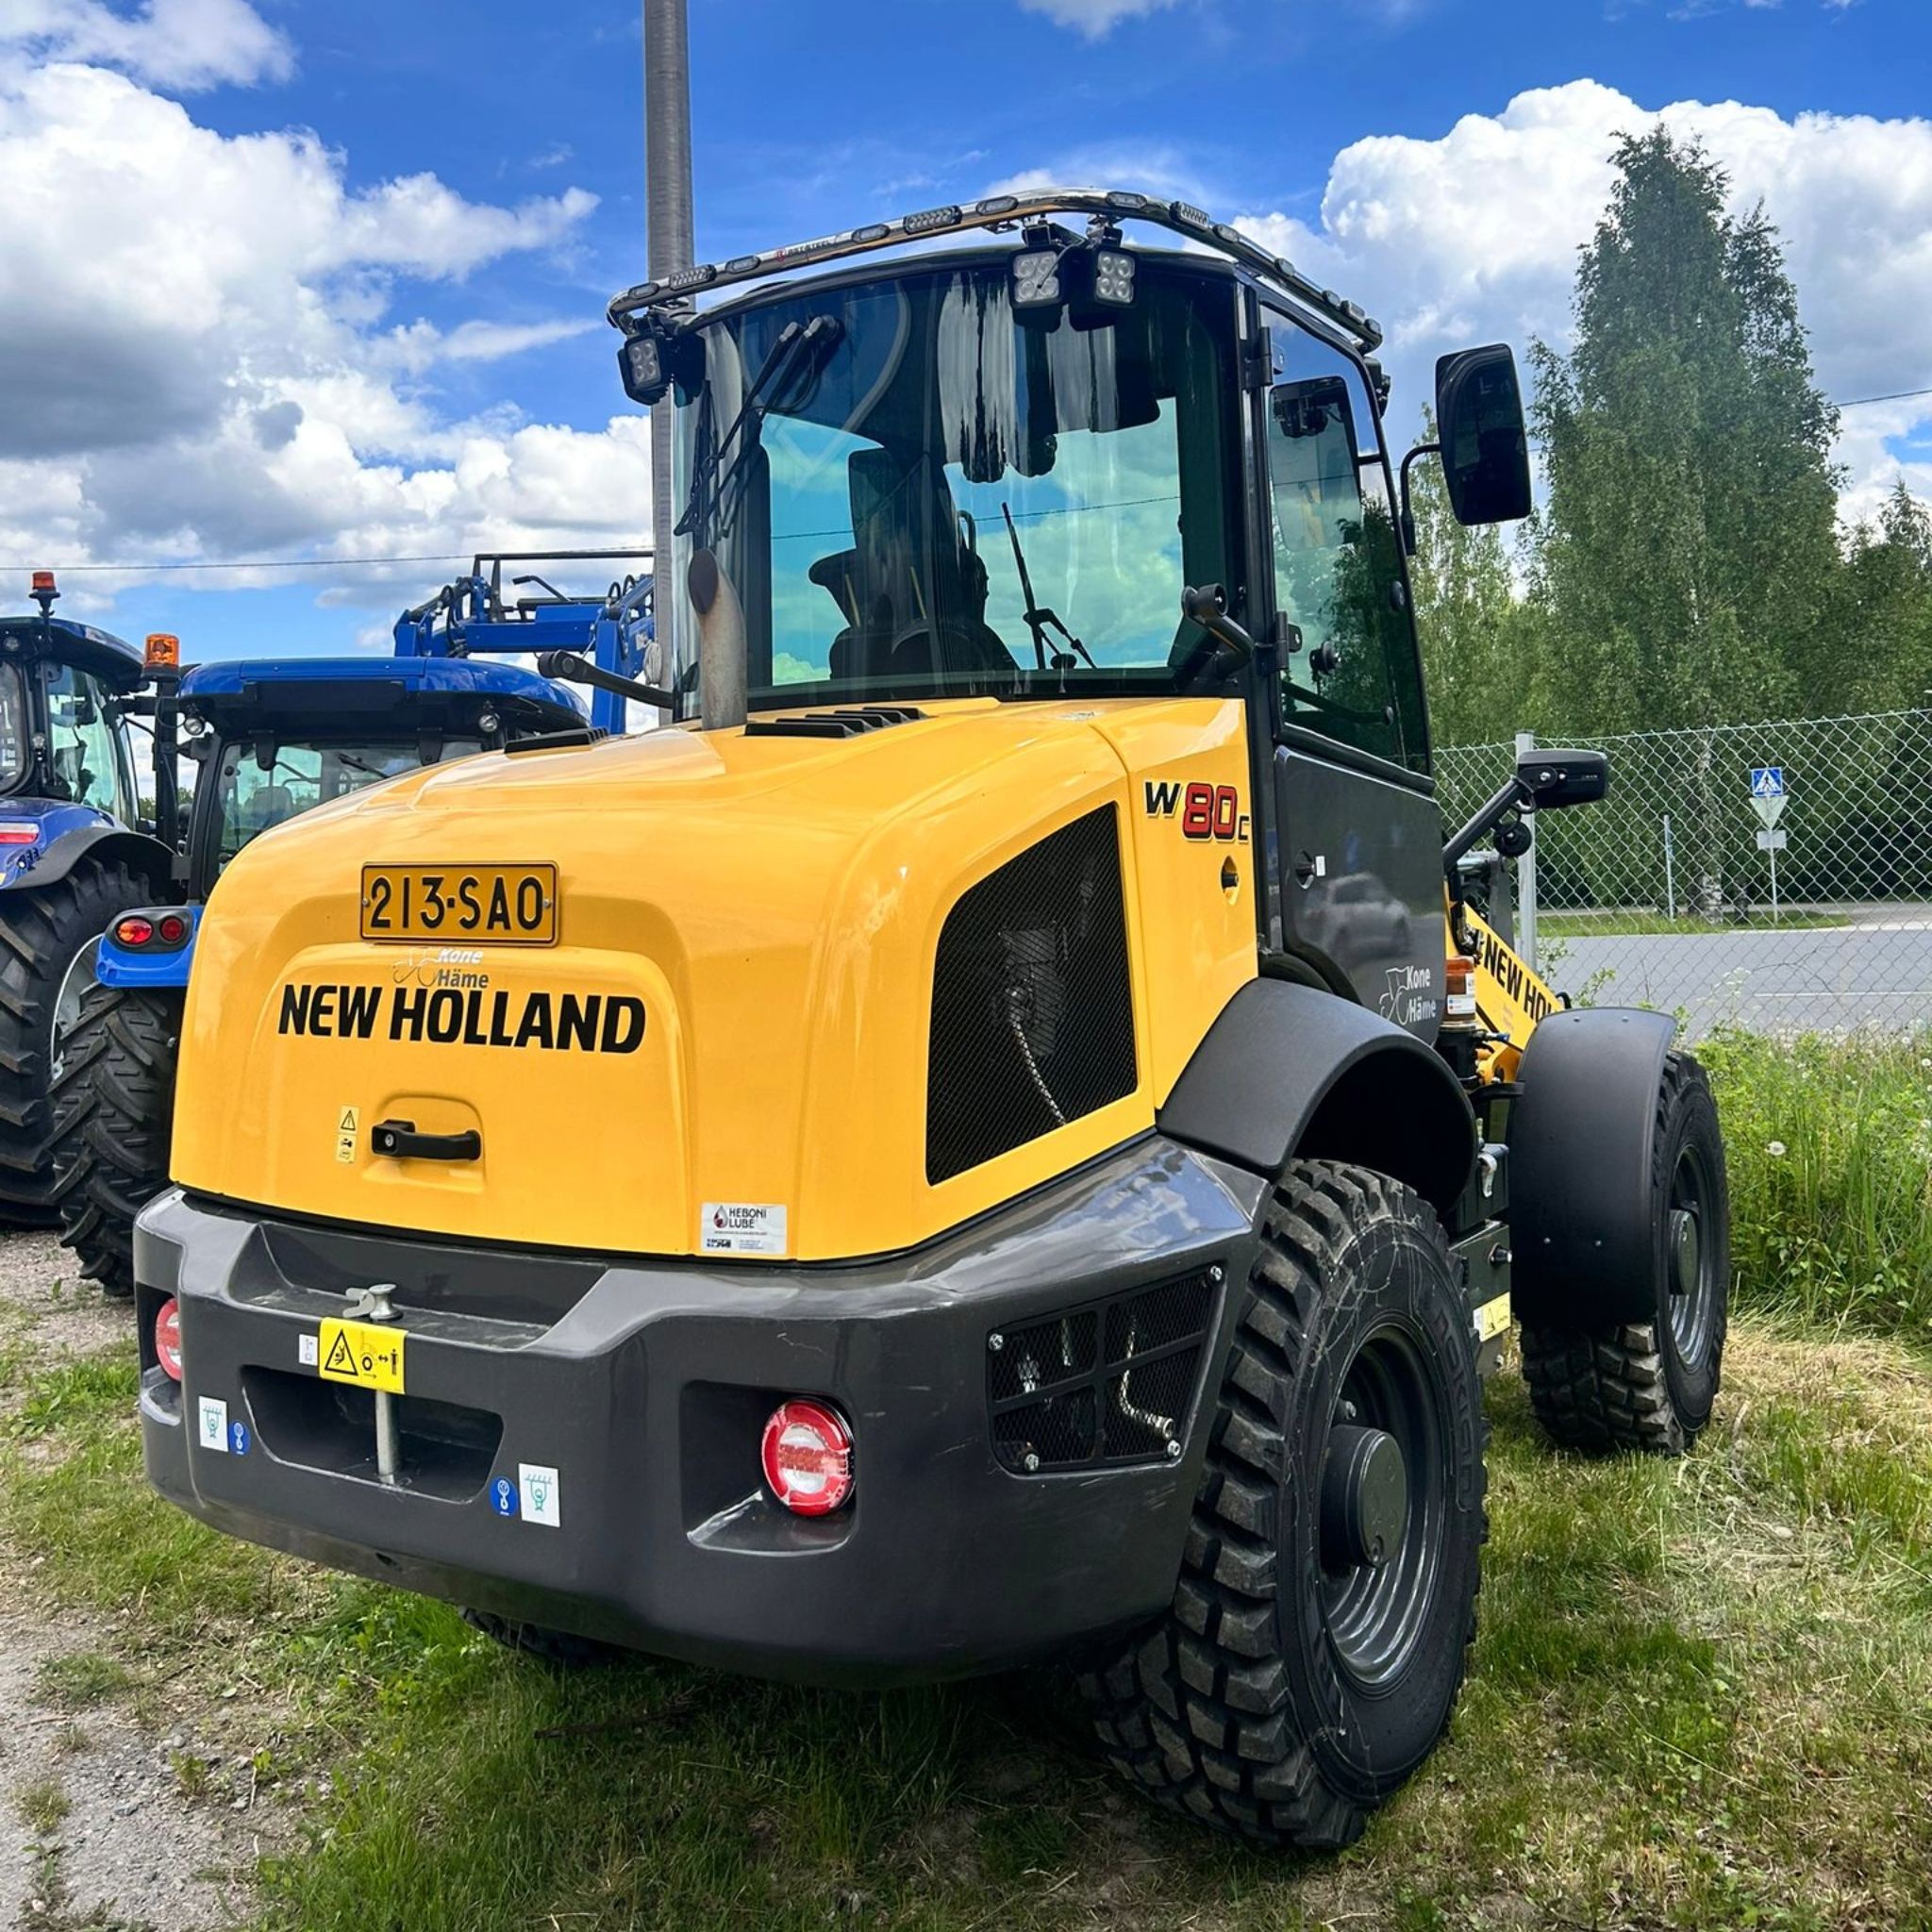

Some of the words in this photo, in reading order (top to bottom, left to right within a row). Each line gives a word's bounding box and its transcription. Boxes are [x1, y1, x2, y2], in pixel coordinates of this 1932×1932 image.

[439, 948, 484, 964] Kone
[1484, 933, 1524, 1003] NEW
[437, 969, 490, 989] Häme
[1407, 965, 1431, 989] Kone
[277, 984, 383, 1039] NEW
[389, 987, 646, 1054] HOLLAND
[1408, 996, 1437, 1023] Häme
[729, 1219, 755, 1228] LUBE
